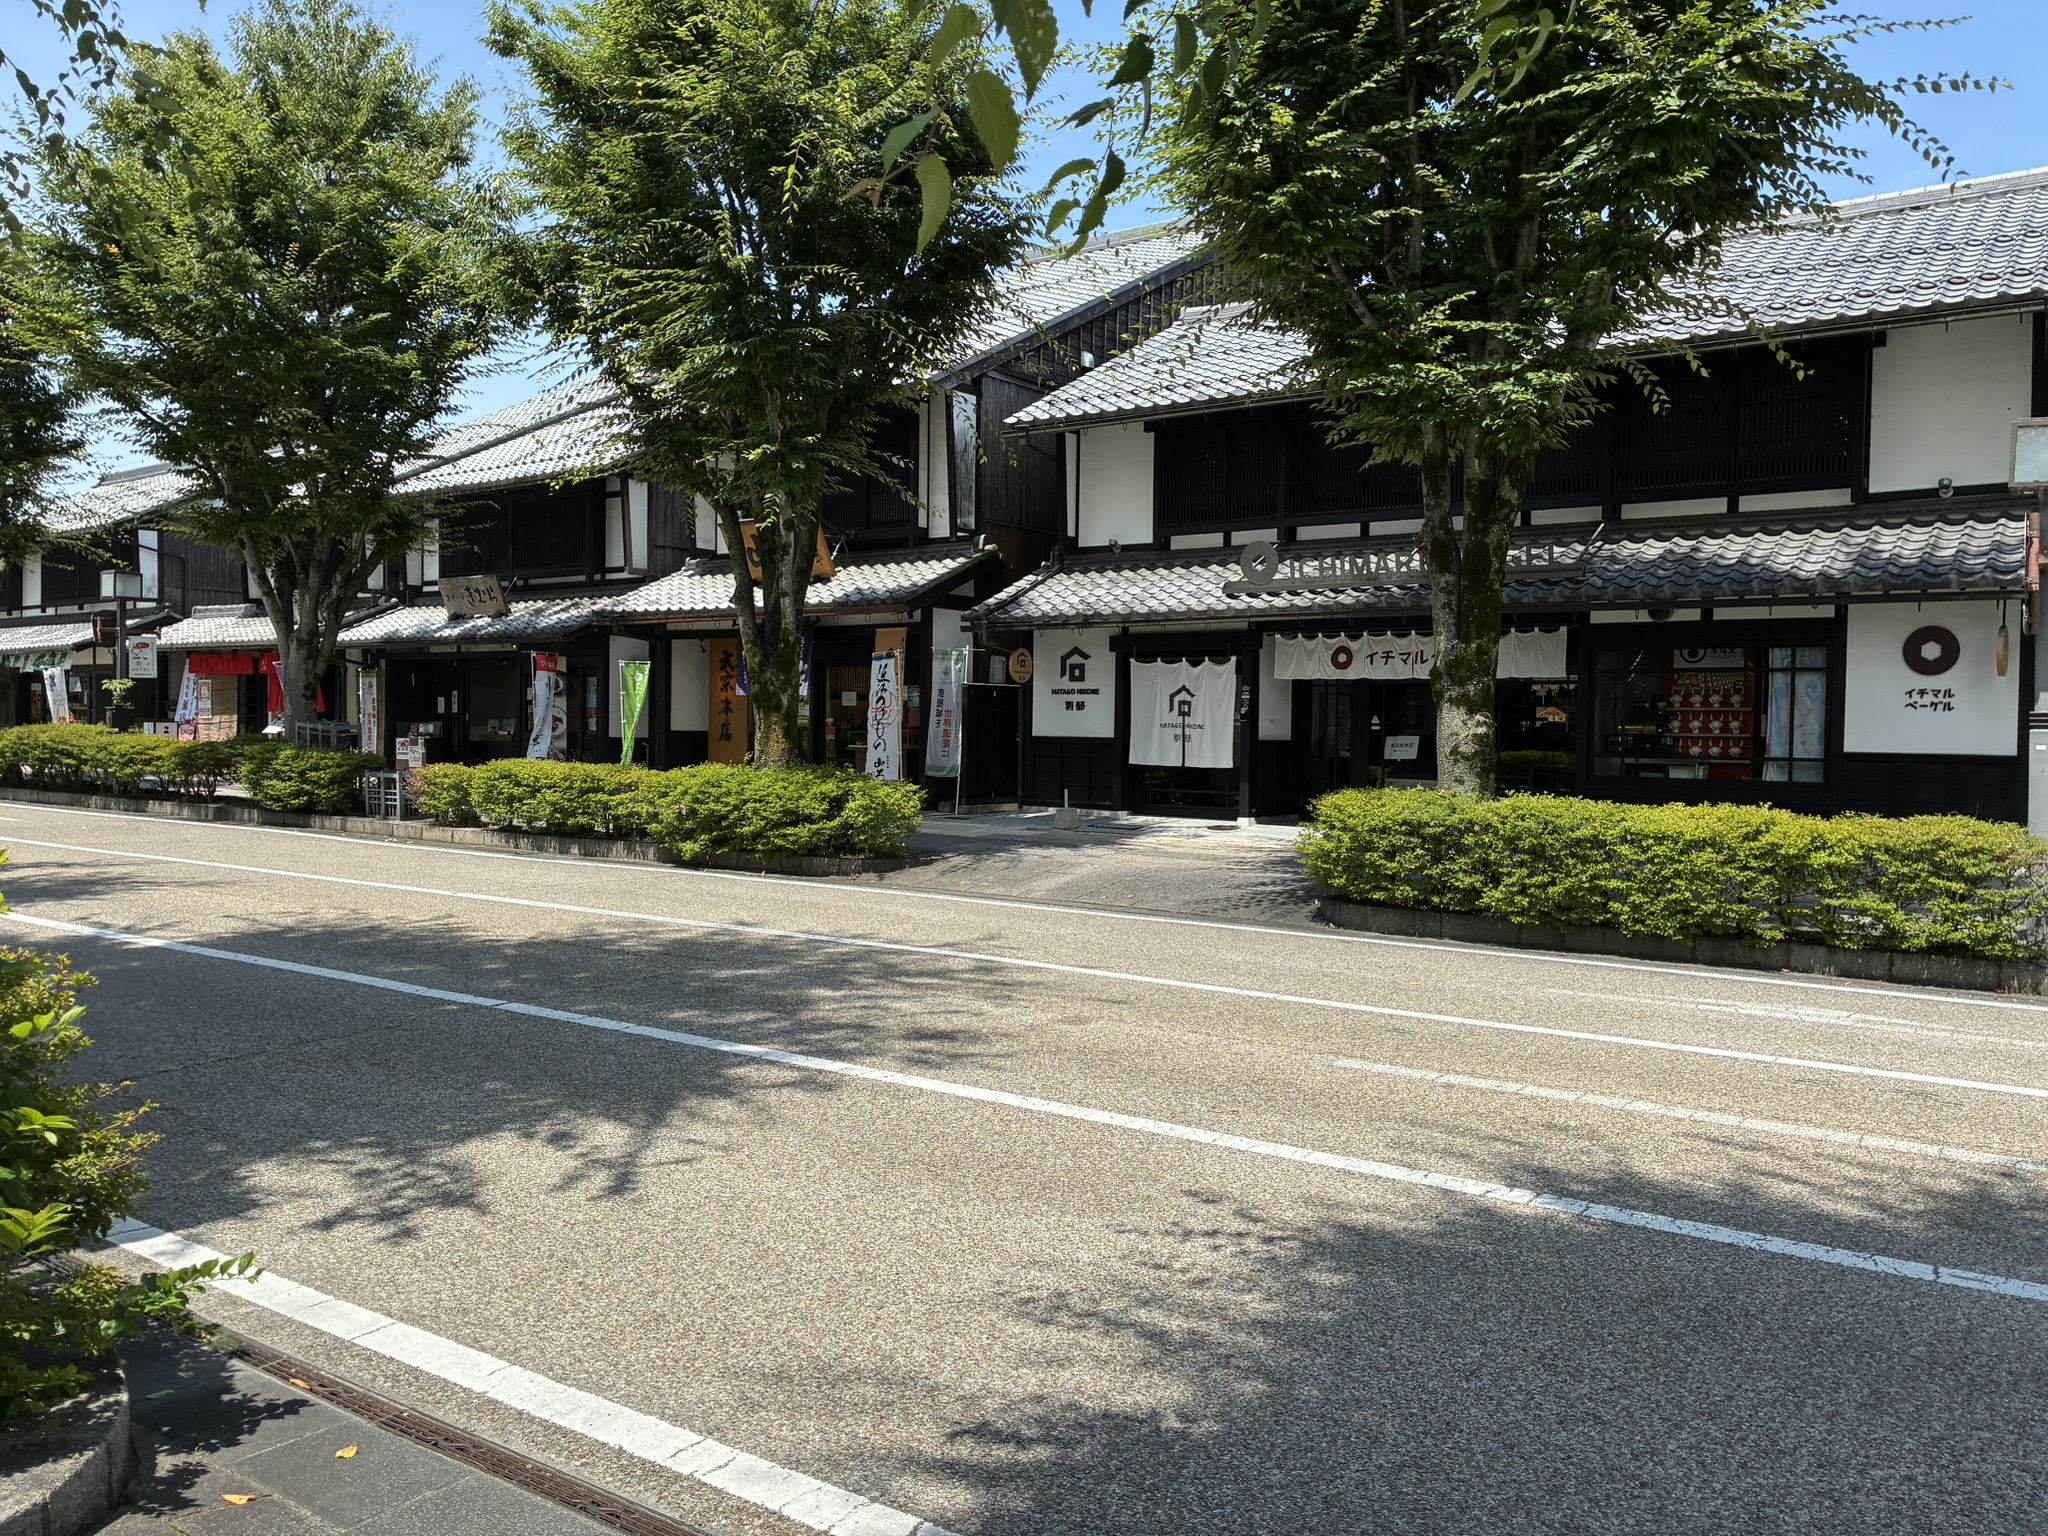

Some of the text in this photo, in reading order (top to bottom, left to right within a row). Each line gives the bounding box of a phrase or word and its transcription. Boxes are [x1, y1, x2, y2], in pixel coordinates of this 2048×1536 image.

[1366, 649, 1435, 665] イチマル
[1904, 688, 1955, 699] イチマル
[1904, 700, 1955, 712] ベーグル
